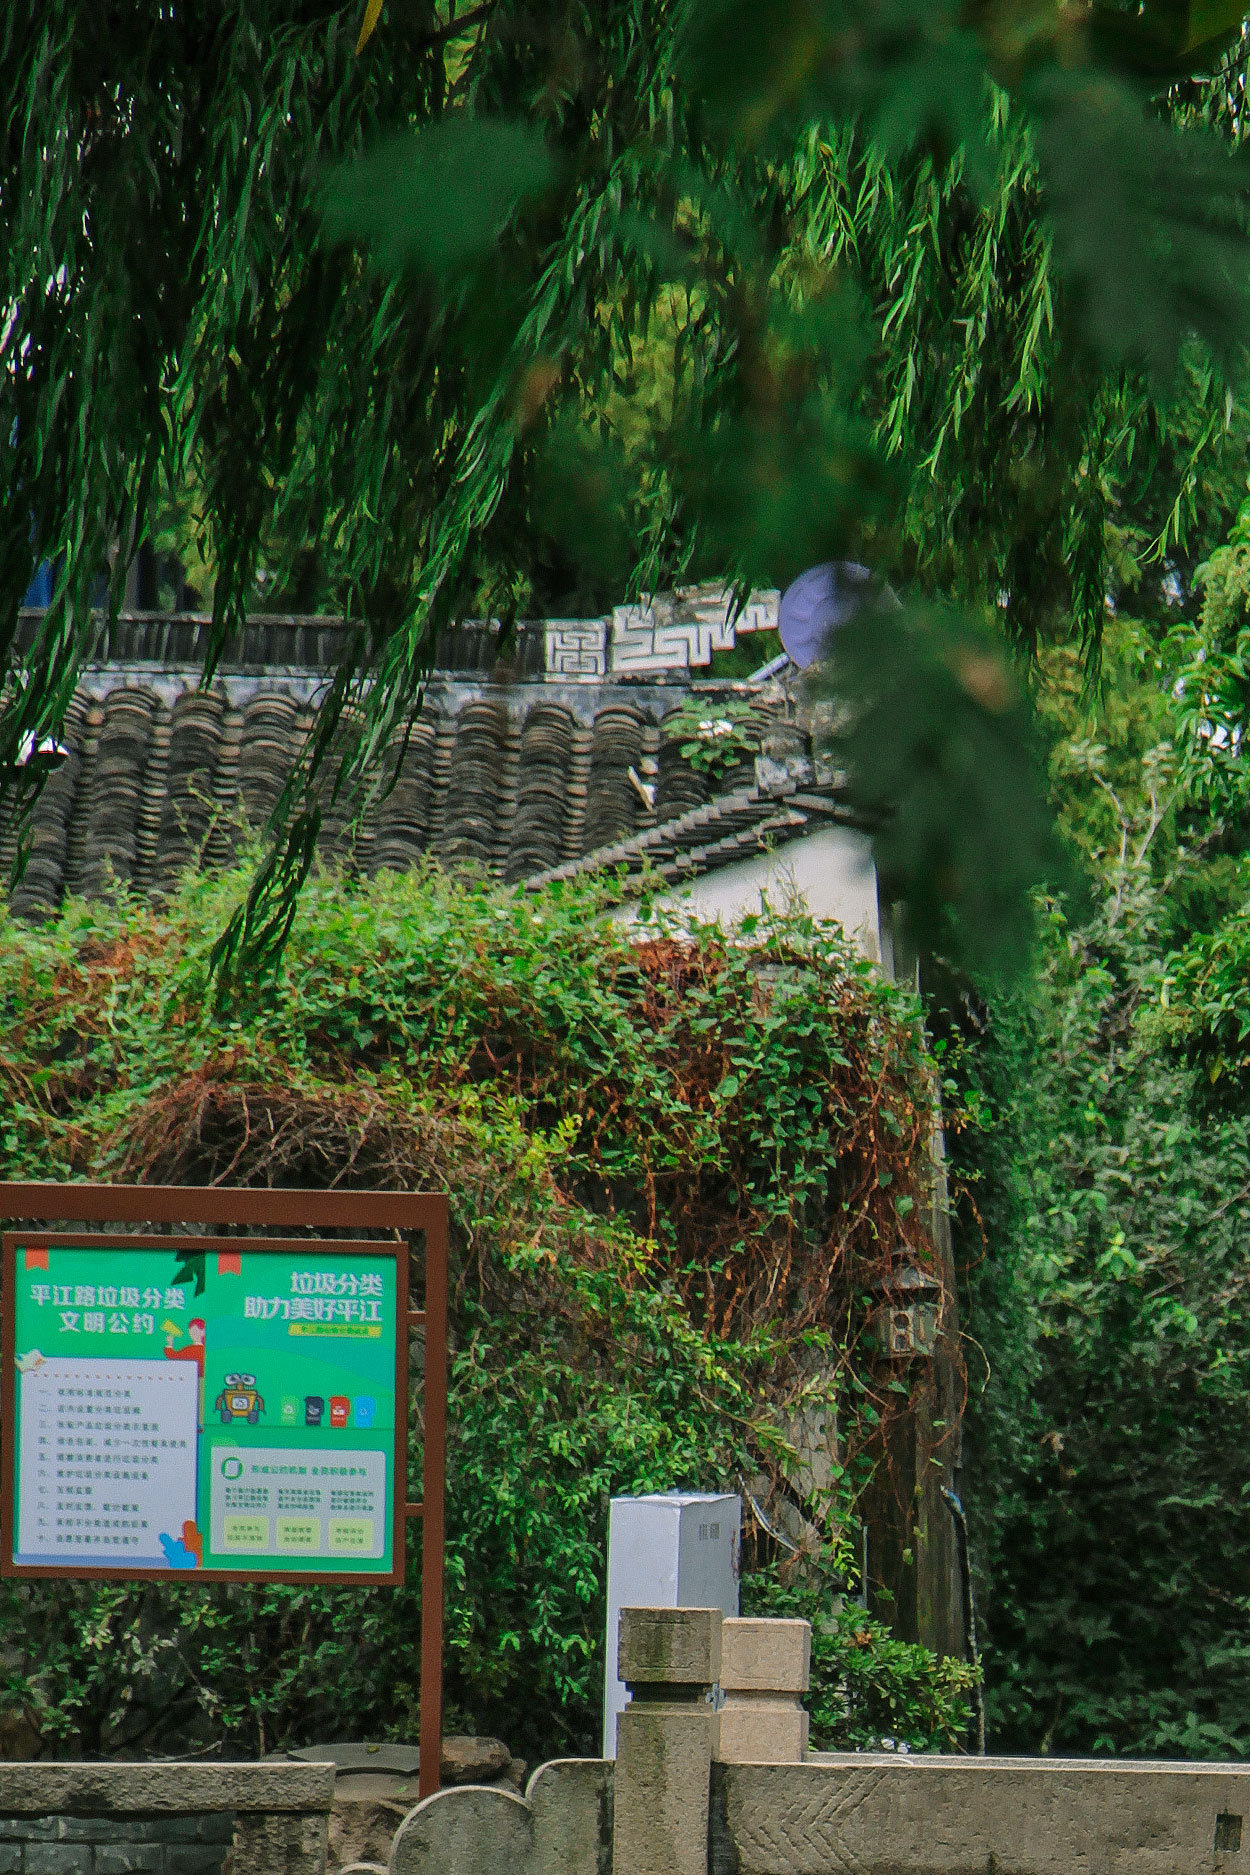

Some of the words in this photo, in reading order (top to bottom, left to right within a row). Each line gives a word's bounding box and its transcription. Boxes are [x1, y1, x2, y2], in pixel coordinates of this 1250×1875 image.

[290, 1271, 382, 1296] 垃圾分类
[30, 1284, 185, 1309] 平江路垃圾分类
[244, 1296, 382, 1321] 助力美好平江
[58, 1310, 154, 1334] 文明公约
